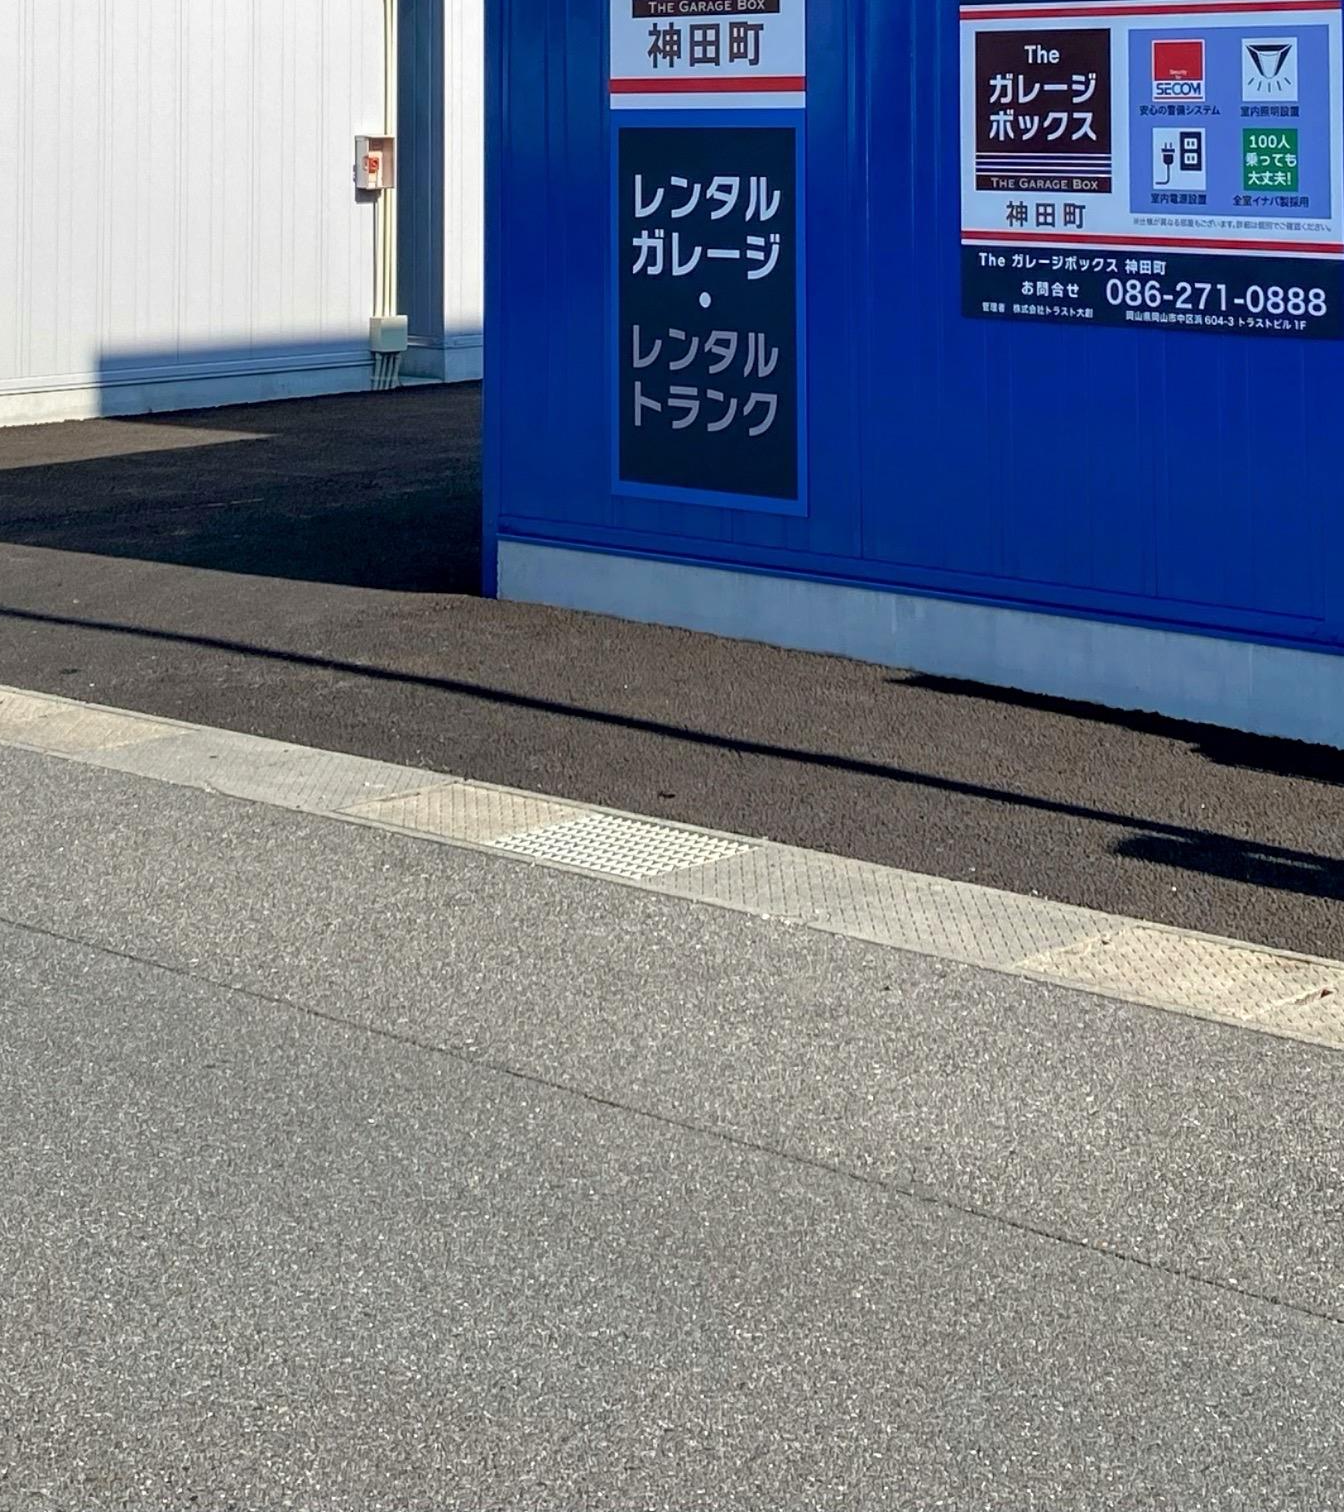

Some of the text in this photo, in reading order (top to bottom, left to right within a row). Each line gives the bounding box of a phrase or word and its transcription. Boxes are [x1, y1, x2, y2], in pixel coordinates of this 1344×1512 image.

[648, 1, 674, 14] THE
[679, 0, 732, 13] GARAGE
[647, 21, 764, 68] 神田町
[1024, 45, 1060, 63] The
[989, 73, 1096, 104] ガレージ
[1156, 82, 1201, 95] SECOM
[1139, 105, 1220, 116] 安心の警備システム
[1240, 106, 1300, 117] 室内照明設置
[989, 109, 1097, 141] ボックス
[1249, 135, 1291, 149] 100人
[1246, 153, 1297, 167] 乗っても
[991, 178, 1098, 189] THE GARAGE BOX
[635, 174, 780, 222] レンタル
[1232, 195, 1310, 208] 全室イナバ製採用
[1006, 201, 1086, 229] 神田町
[632, 229, 780, 280] ガレージ
[979, 253, 1166, 276] The ガレージボックス 神田町
[1021, 280, 1080, 298] お問合せ
[1106, 278, 1327, 316] 086-271-0888
[1204, 316, 1235, 327] 604-3
[1238, 318, 1292, 330] トラストビル
[1294, 320, 1306, 331] 1F
[633, 324, 779, 378] レンタル
[634, 381, 778, 437] トランク
